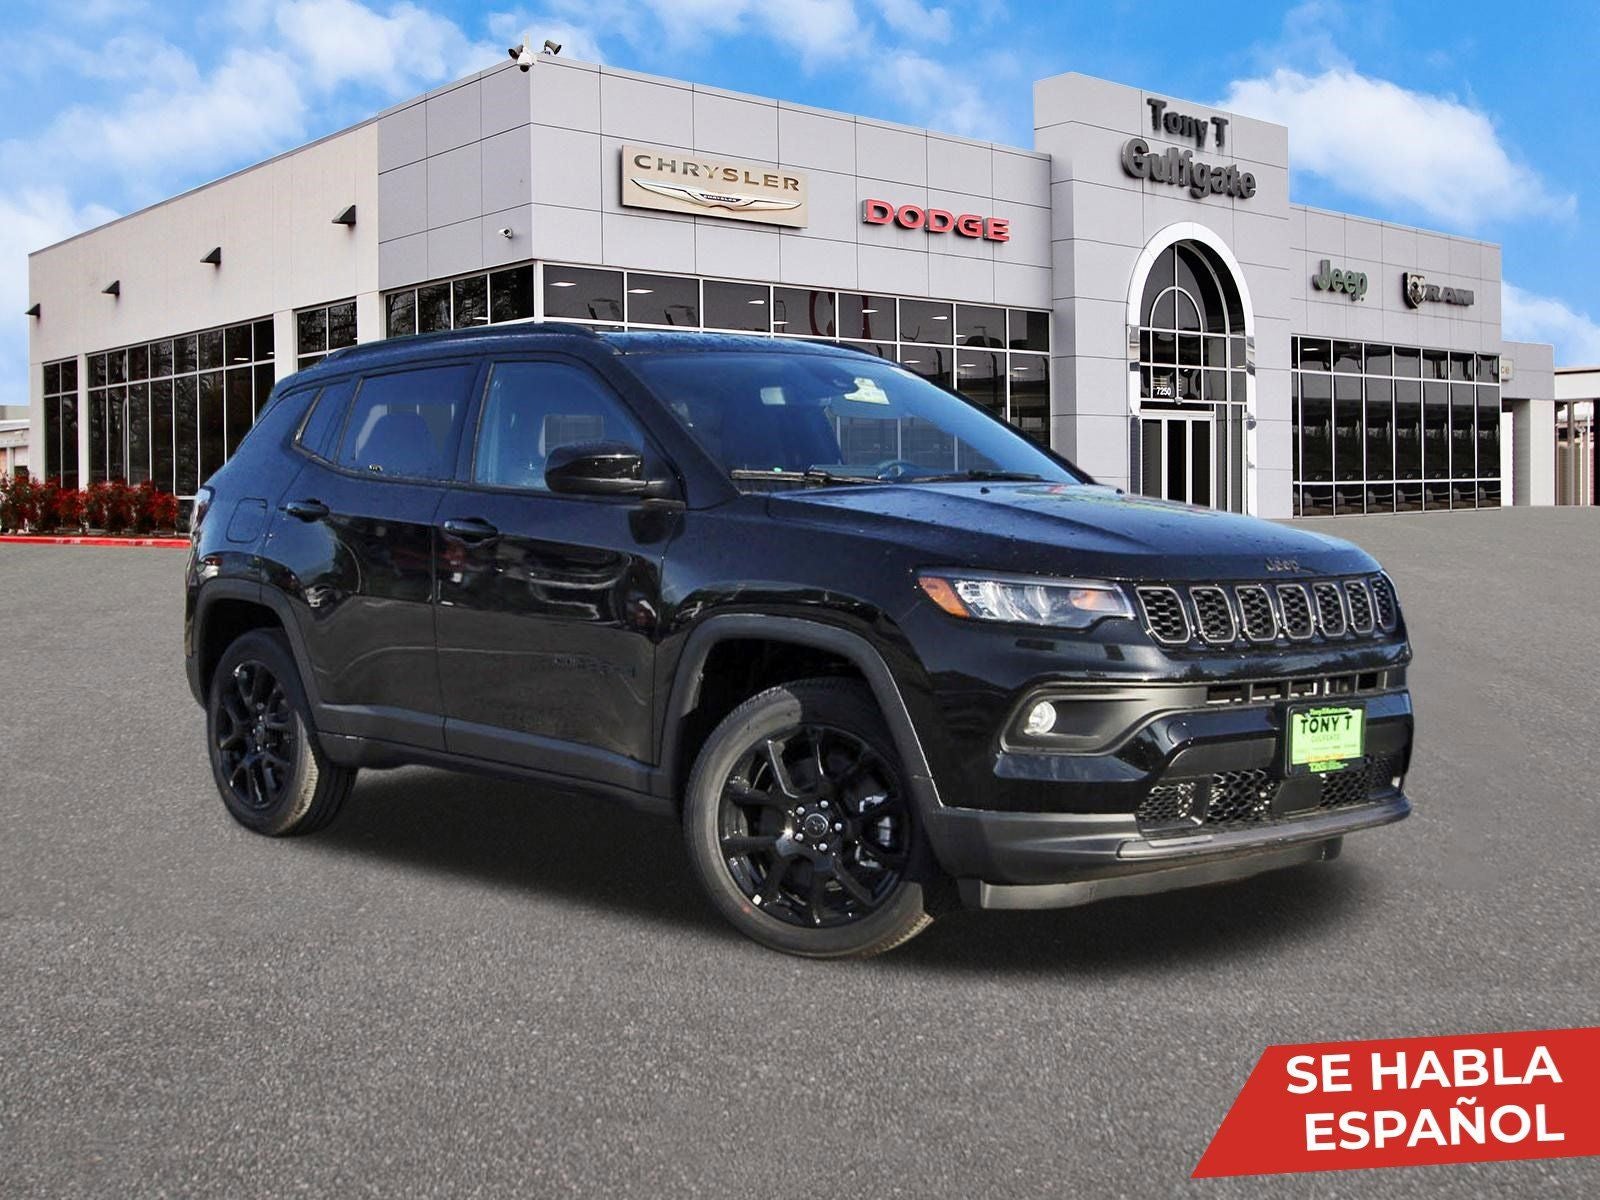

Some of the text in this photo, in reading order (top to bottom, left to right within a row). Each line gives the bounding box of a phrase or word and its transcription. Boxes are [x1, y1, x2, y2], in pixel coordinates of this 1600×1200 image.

[1146, 98, 1229, 148] Tony T
[633, 154, 800, 192] CHRYSLER
[1120, 138, 1257, 199] Gulfgate
[862, 199, 1010, 242] DODGE
[1312, 259, 1368, 302] Jeep
[1424, 283, 1475, 306] RAM
[1156, 386, 1172, 396] 7250
[1301, 715, 1353, 734] TONY T
